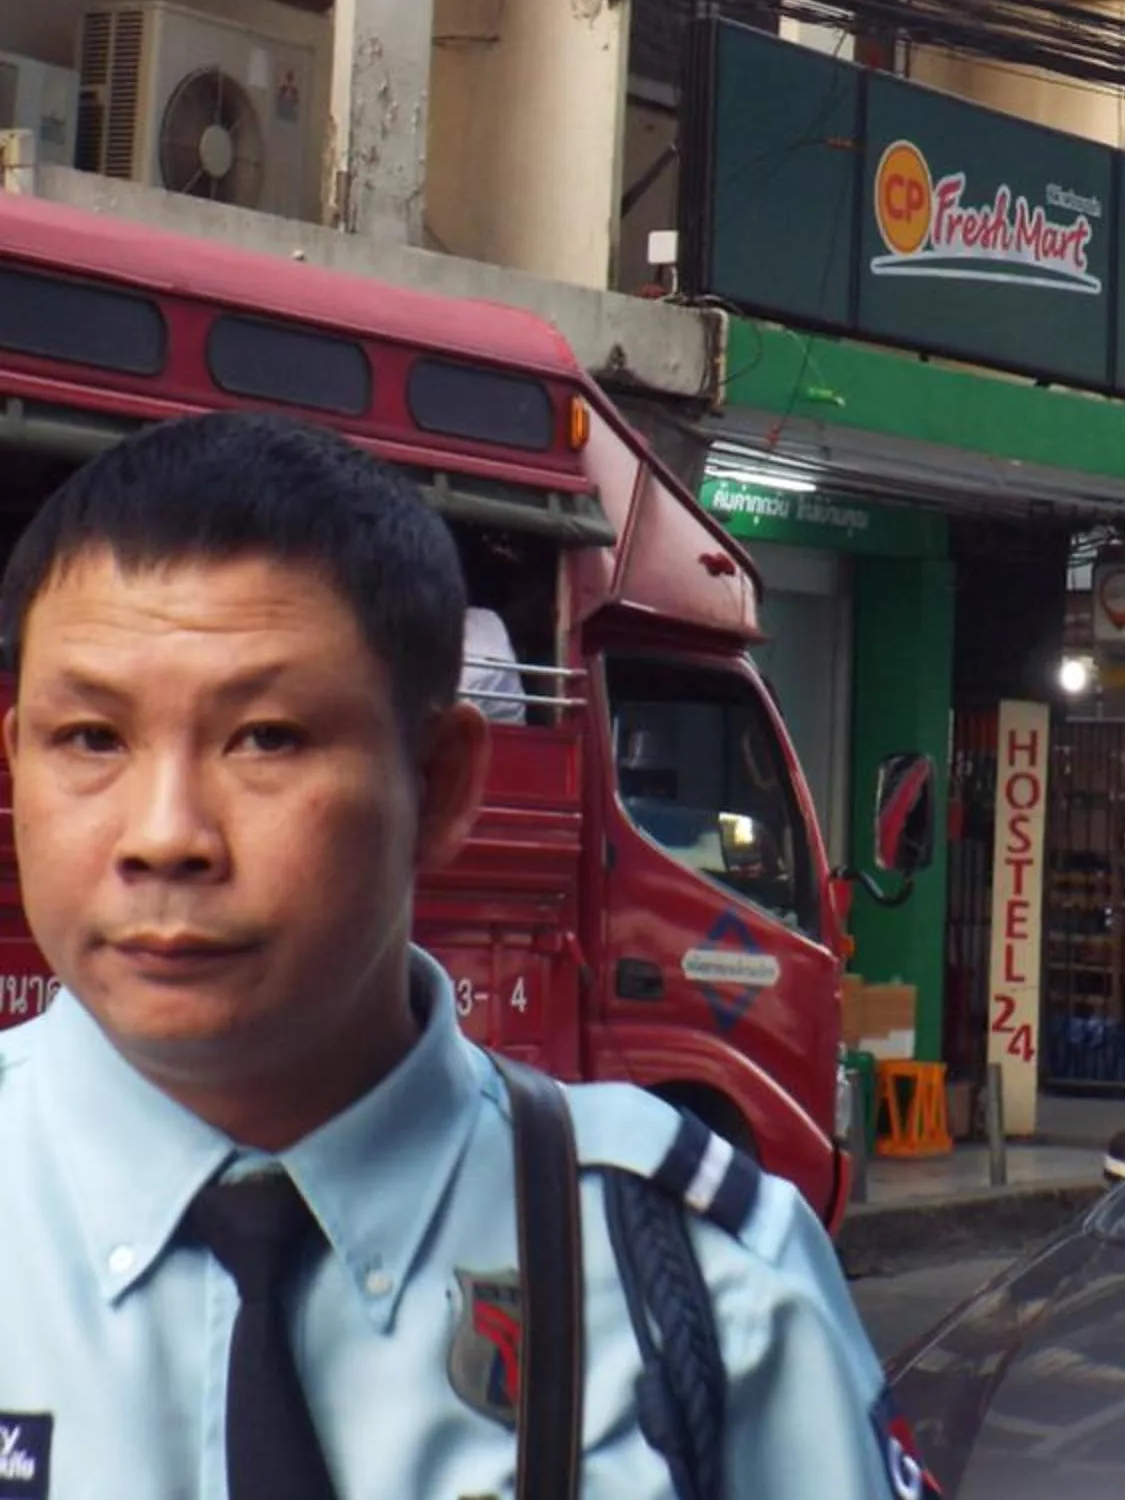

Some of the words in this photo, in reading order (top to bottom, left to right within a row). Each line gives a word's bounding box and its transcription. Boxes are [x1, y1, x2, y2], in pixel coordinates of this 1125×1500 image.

[884, 173, 926, 223] CP
[932, 178, 1011, 246] Fresh
[1015, 197, 1090, 268] Mart
[1005, 729, 1040, 984] HOSTEL
[991, 995, 1035, 1062] 24
